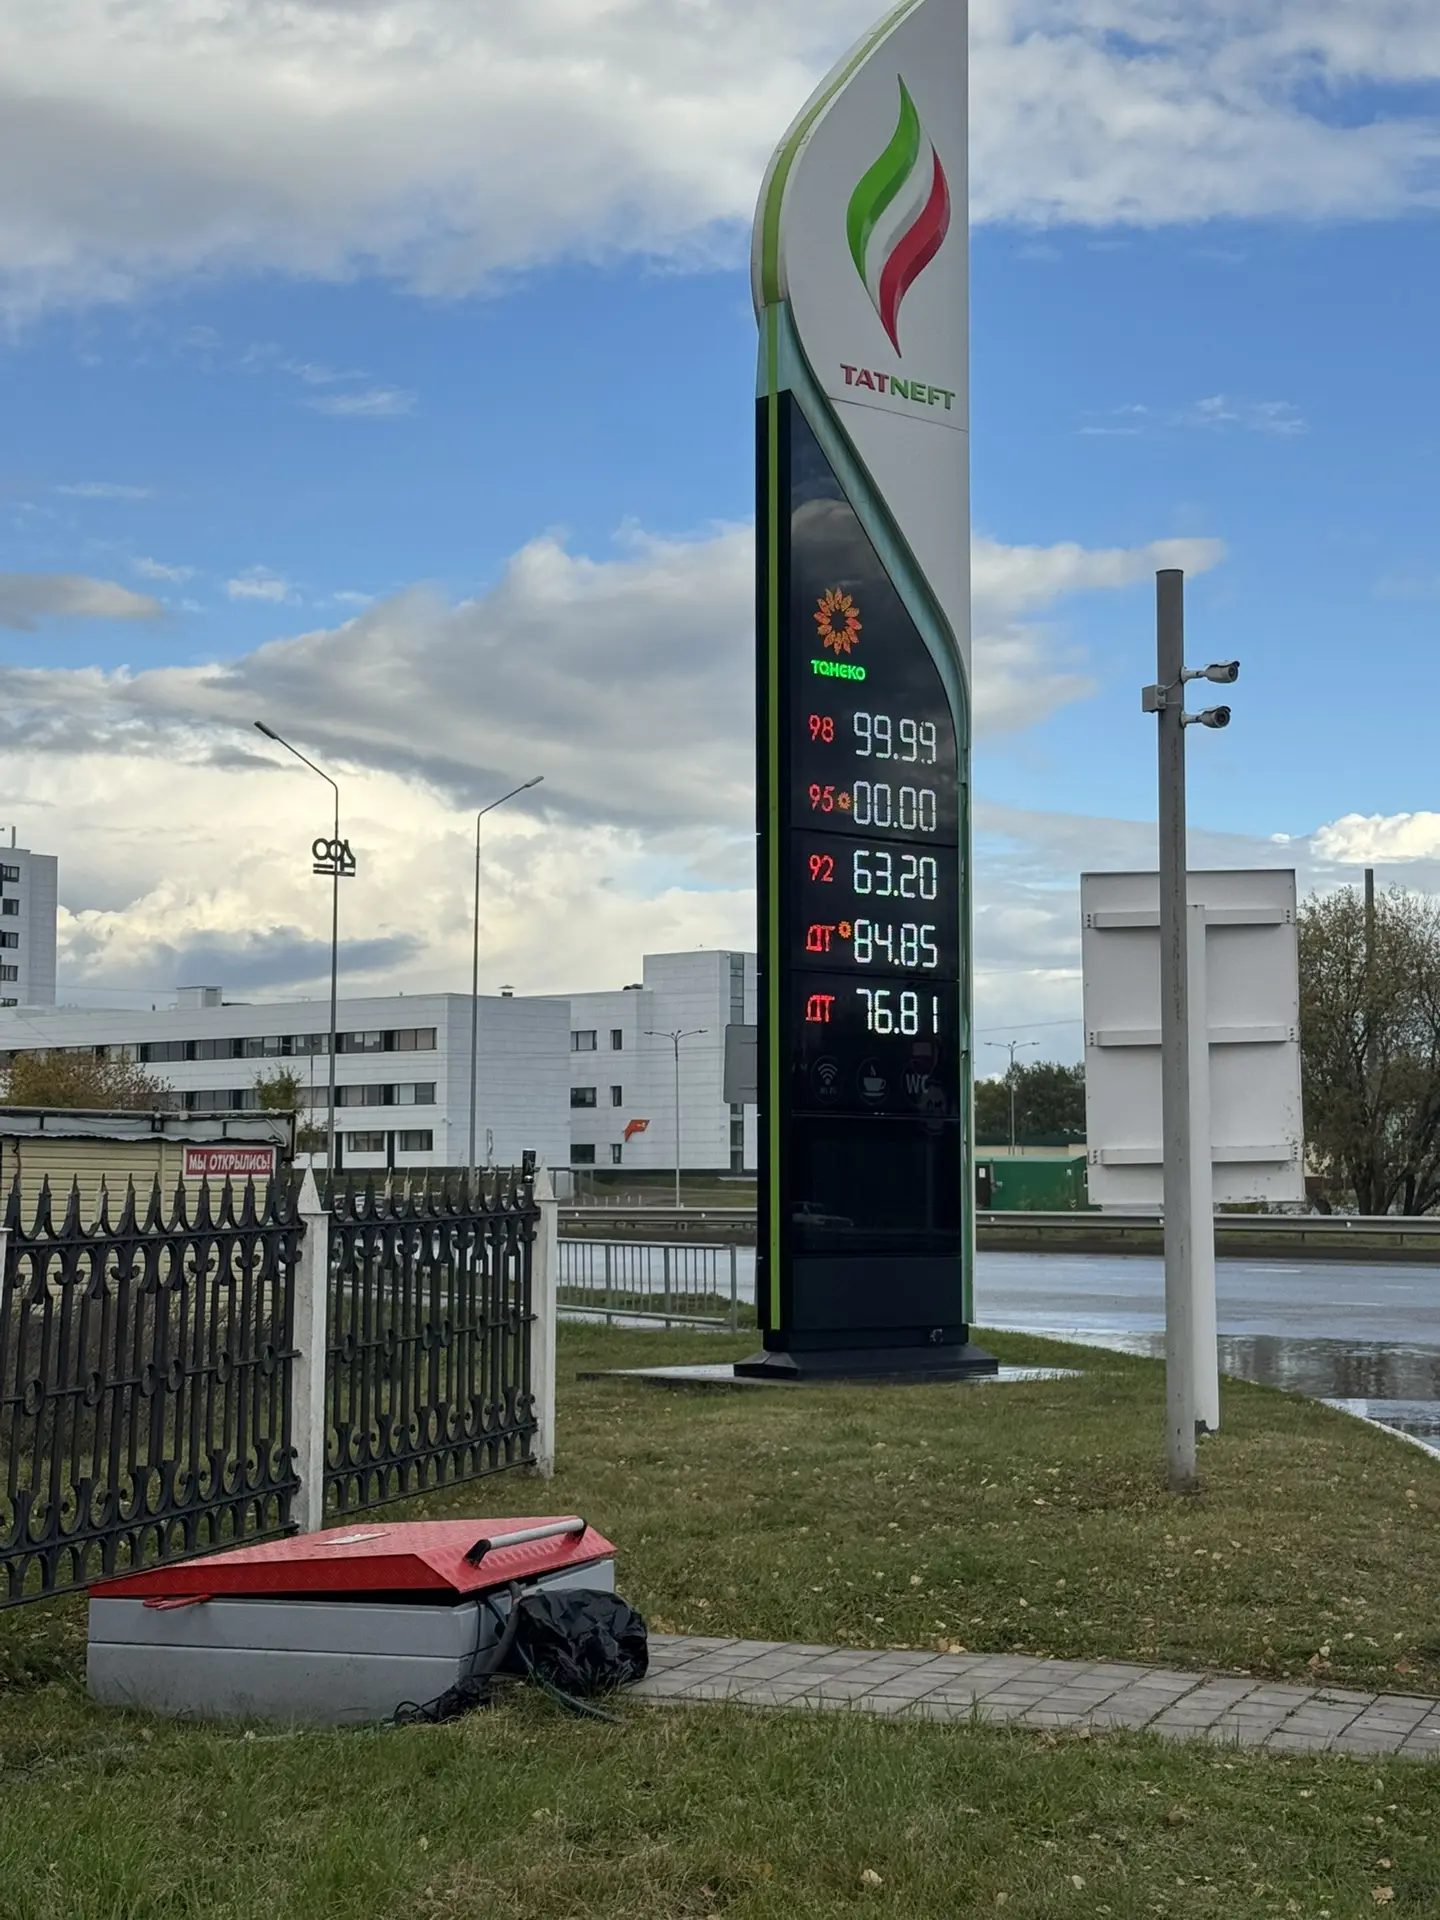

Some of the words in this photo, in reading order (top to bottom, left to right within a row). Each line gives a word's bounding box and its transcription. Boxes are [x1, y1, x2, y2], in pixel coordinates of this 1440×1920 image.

[840, 363, 955, 410] TATNEFT
[808, 715, 834, 743] 98
[853, 712, 937, 764] 99.99
[808, 784, 835, 812] 95
[853, 781, 937, 831] 00.00
[809, 855, 834, 882] 92
[853, 850, 937, 900] 63.20
[806, 925, 835, 952] ДТ
[854, 919, 938, 968] 84.85
[806, 995, 835, 1022] ДТ
[856, 988, 938, 1035] 76.81
[905, 1074, 929, 1094] WC
[189, 1153, 206, 1170] МЫ
[209, 1153, 271, 1170] ОТКРЫЛИСЬ!
